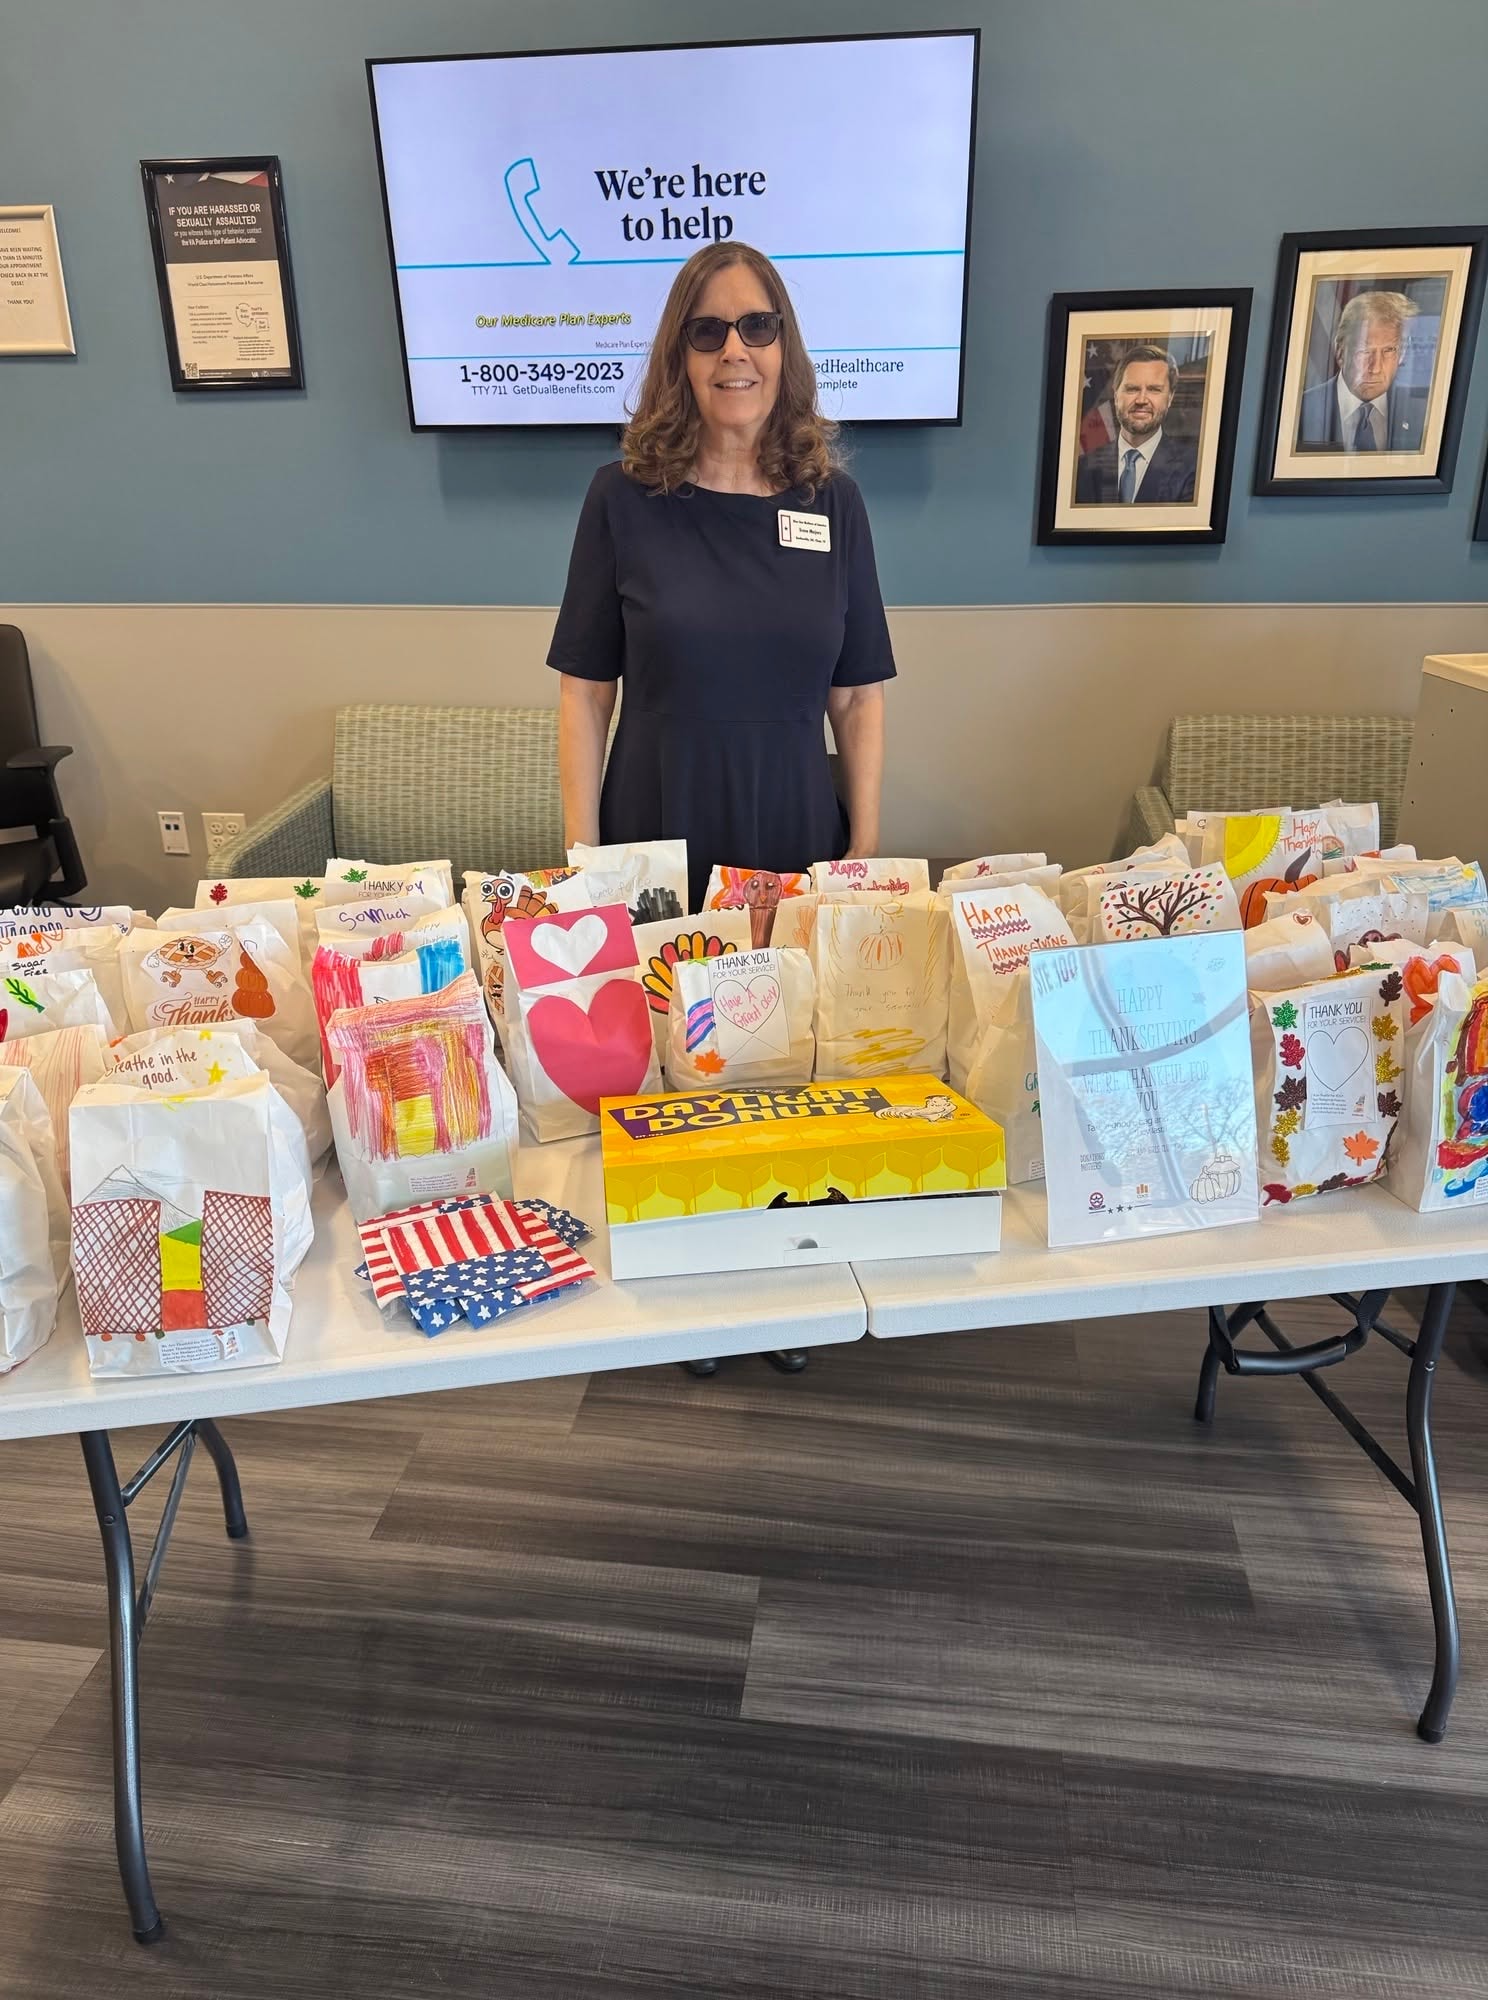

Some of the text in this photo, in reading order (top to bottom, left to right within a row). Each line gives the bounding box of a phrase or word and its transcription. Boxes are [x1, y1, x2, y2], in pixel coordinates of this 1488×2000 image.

[692, 163, 766, 198] here
[168, 203, 261, 216] IF YOU ARE HARASSED OR
[176, 215, 257, 228] SEXUALLY ASSAULTED
[620, 205, 733, 244] to help
[204, 228, 212, 236] this
[212, 229, 222, 237] type
[475, 311, 632, 328] Our Medicare Plan Experts
[595, 340, 618, 348] Medicare
[460, 361, 625, 383] 1-800-349-2023
[813, 358, 904, 373] edHealthcare
[472, 384, 616, 395] TTY 711 GetDualBenefits.com
[816, 379, 858, 391] omplete
[827, 860, 869, 879] Happy
[960, 900, 1022, 928] HAPPY
[11, 959, 45, 971] Sugar
[715, 951, 770, 971] THANK YOU
[23, 967, 48, 977] Free
[713, 971, 727, 979] FOR
[728, 967, 747, 977] YOUR
[194, 996, 220, 1005] HAPPY
[1116, 985, 1164, 1014] HAPPY
[1310, 1001, 1363, 1019] THANK YOU
[1307, 1020, 1318, 1029] FOR
[1320, 1018, 1338, 1027] YOUR
[1088, 1019, 1198, 1055] THANKSGIVING
[158, 1052, 174, 1066] in
[175, 1047, 198, 1063] the
[142, 1067, 178, 1090] good.
[1187, 1060, 1209, 1082] FOR
[624, 1087, 873, 1121] DAYLIGHT
[1136, 1090, 1159, 1112] YOU
[649, 1100, 871, 1132] DONUTS
